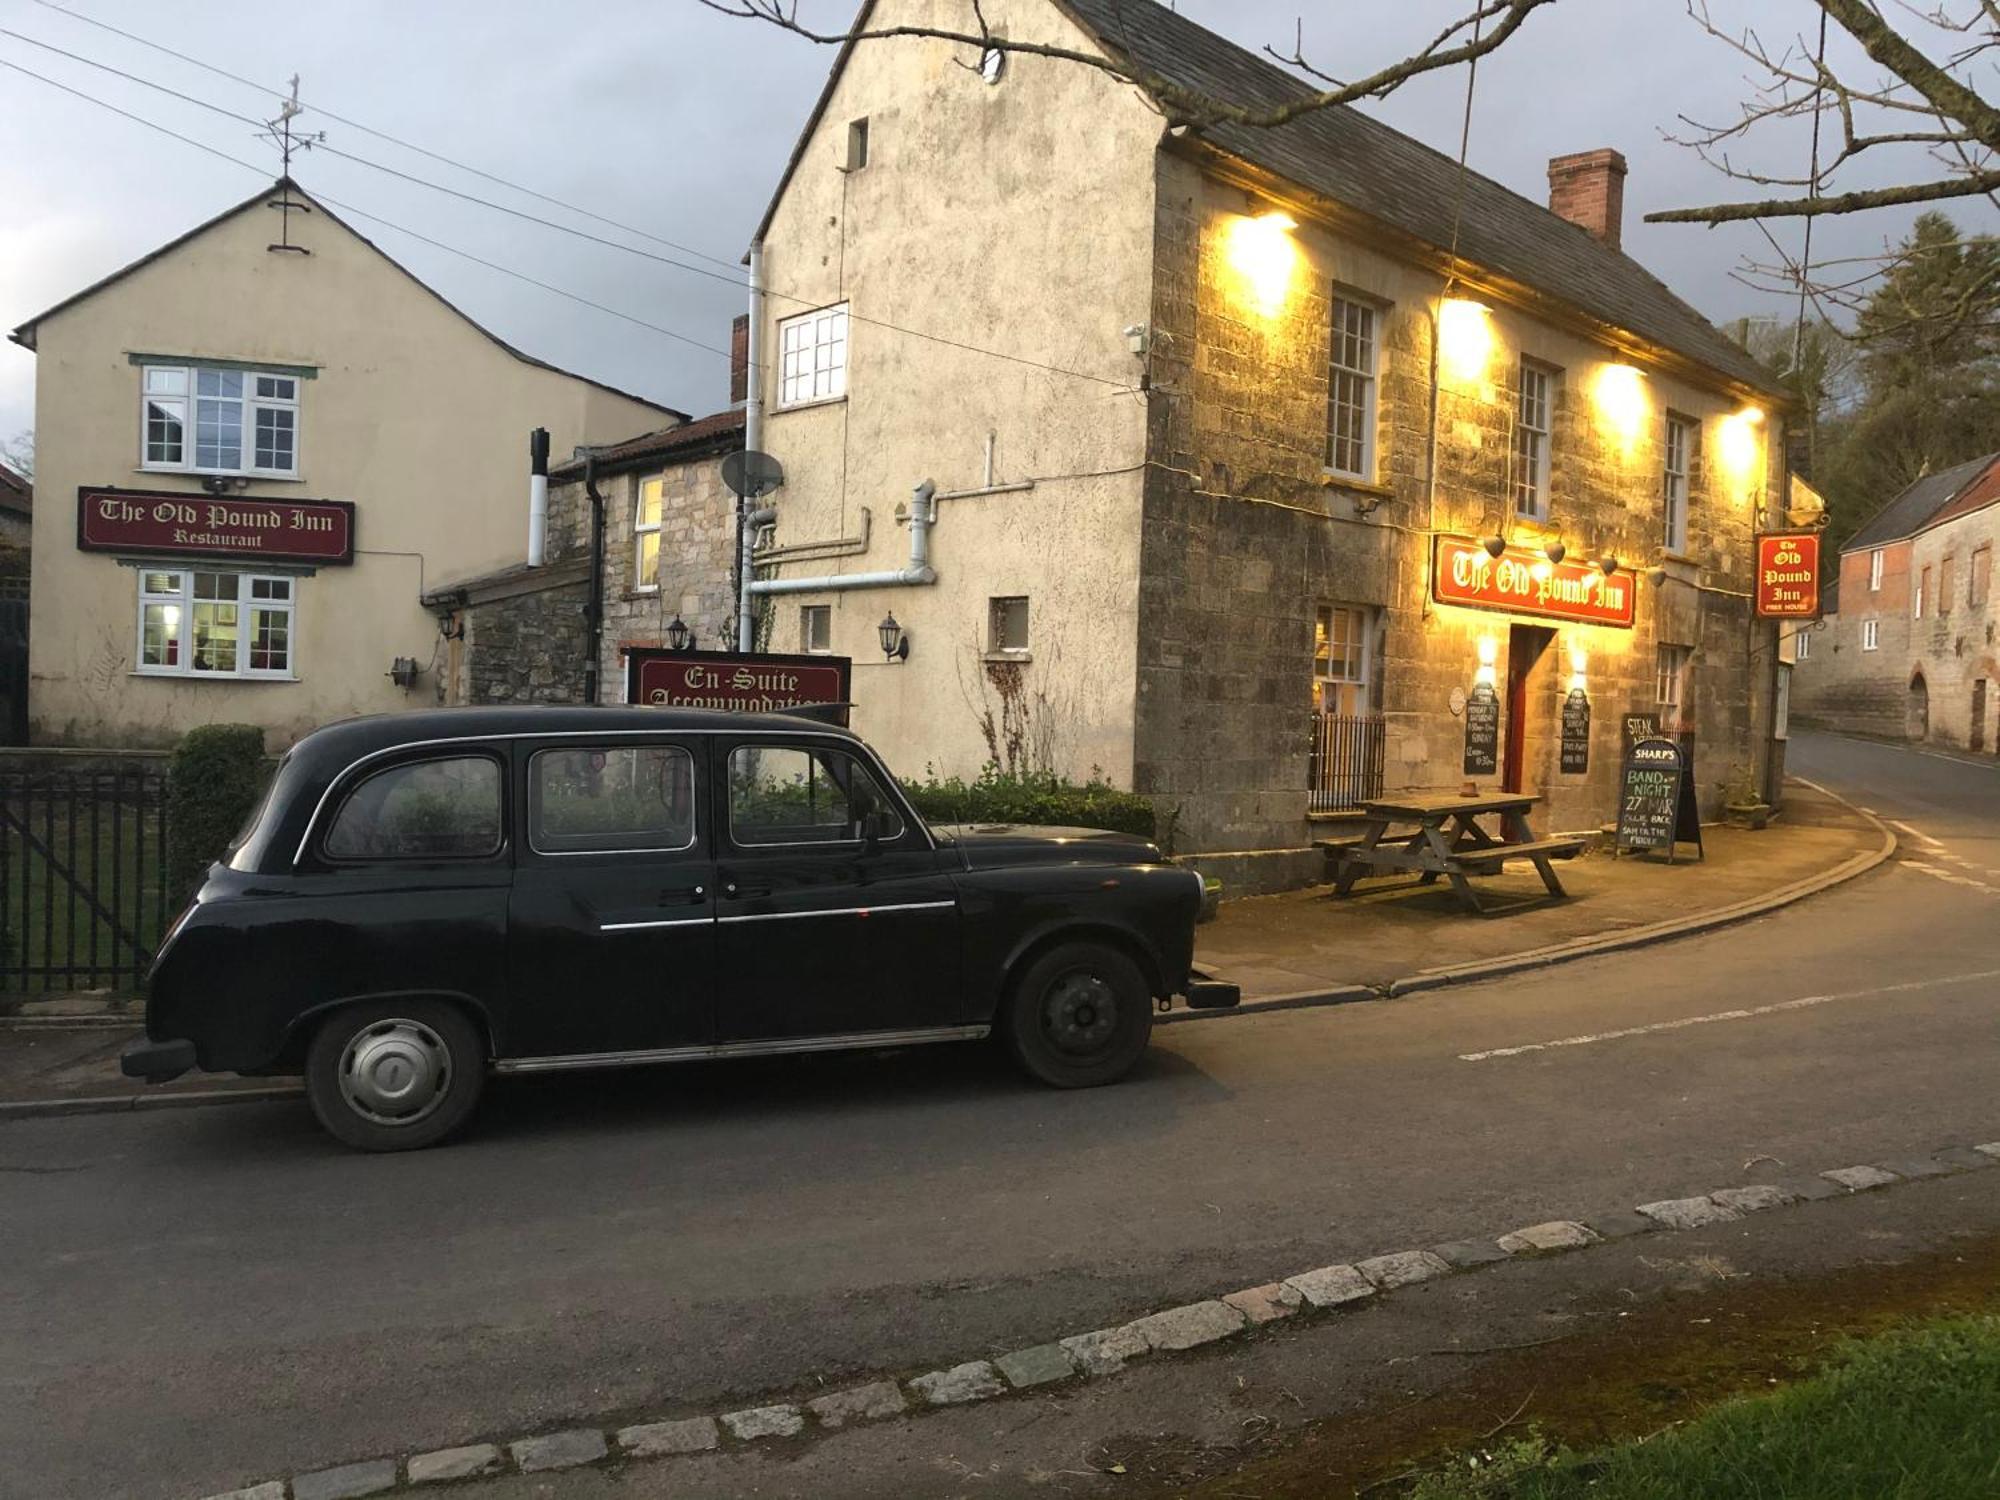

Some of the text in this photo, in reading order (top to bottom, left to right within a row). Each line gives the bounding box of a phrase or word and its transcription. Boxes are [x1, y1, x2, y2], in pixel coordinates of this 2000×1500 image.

[99, 498, 333, 532] The Old Pound Inn
[173, 528, 262, 547] Restaurant
[1780, 541, 1797, 550] The
[1774, 551, 1801, 565] Old
[1452, 550, 1625, 611] The Old Pound Inn
[1764, 569, 1812, 586] Pound
[1772, 587, 1801, 601] Inn
[1627, 718, 1654, 735] STEAK
[1634, 749, 1675, 760] SHARP'S
[1634, 783, 1672, 798] NIGHT
